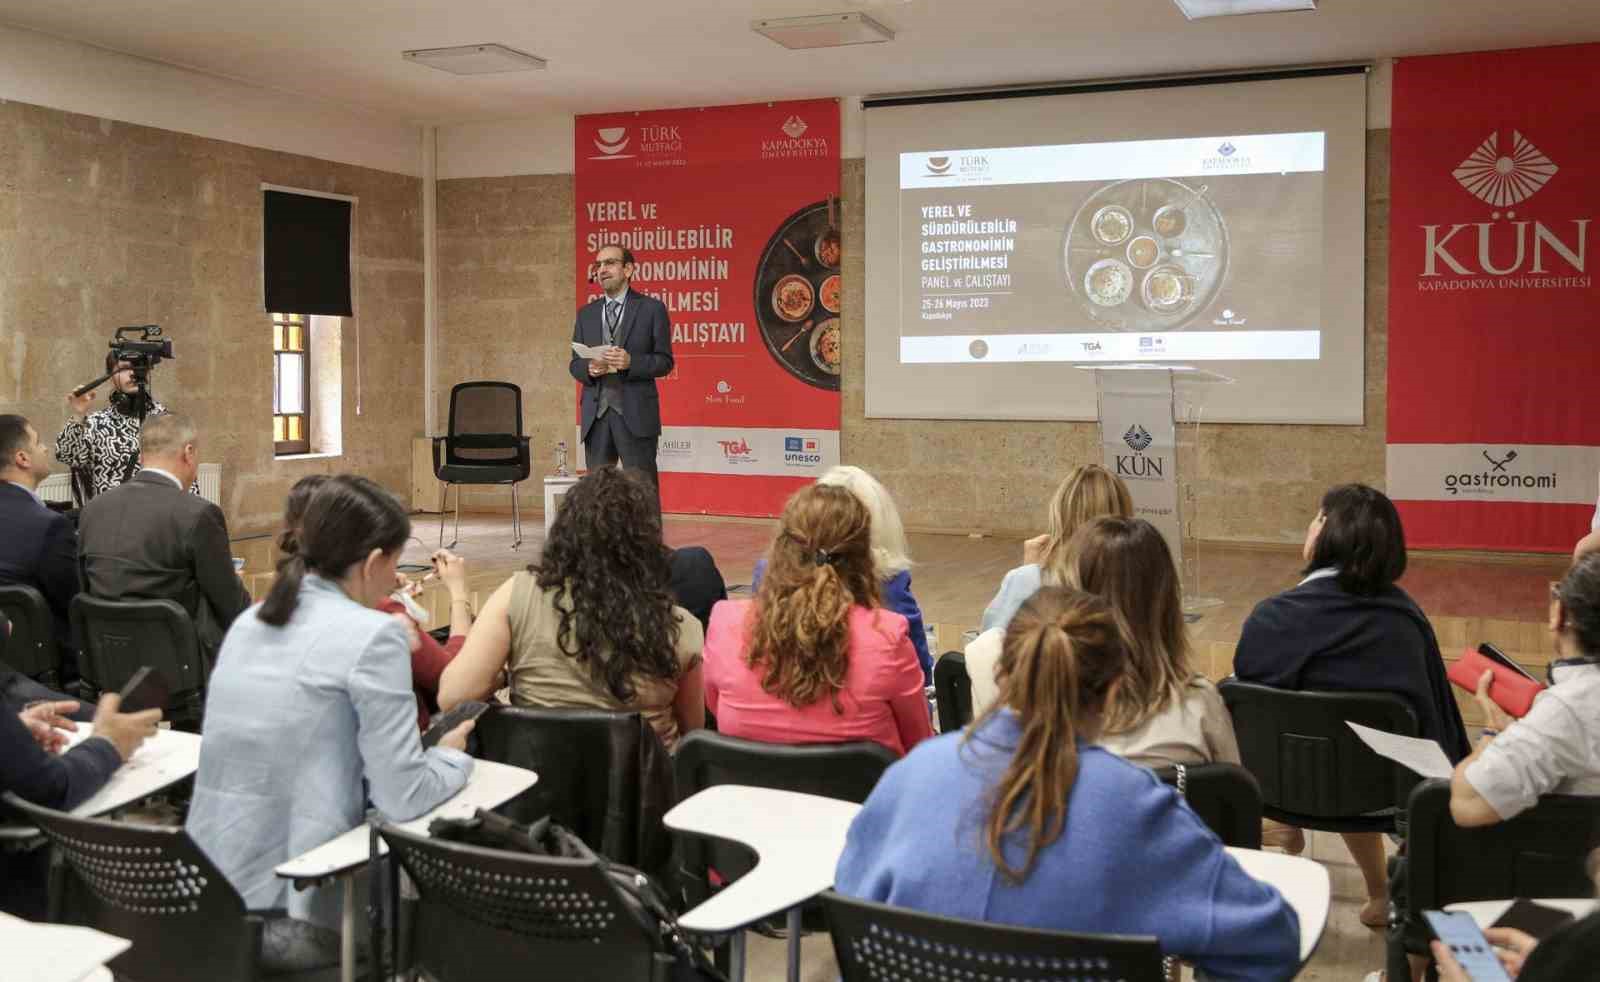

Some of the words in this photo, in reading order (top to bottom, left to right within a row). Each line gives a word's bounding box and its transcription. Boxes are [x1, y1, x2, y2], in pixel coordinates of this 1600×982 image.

[640, 124, 682, 142] TÜRK
[586, 201, 636, 222] YEREL
[640, 203, 657, 220] VE
[921, 205, 954, 218] YEREL
[958, 204, 972, 217] VE
[921, 218, 1017, 236] SÜRDÜRÜLEBİLİR
[921, 236, 1014, 253] GASTRONOMİNİN
[1418, 210, 1592, 277] KÜN
[921, 254, 1008, 272] GELİŞTİRİLMESİ
[921, 275, 952, 289] PANEL
[1417, 279, 1495, 291] KAPADOKYA
[717, 437, 753, 457] TGA
[784, 454, 820, 463] unesco
[1116, 452, 1163, 476] KÜN
[1445, 472, 1557, 494] gastronomi
